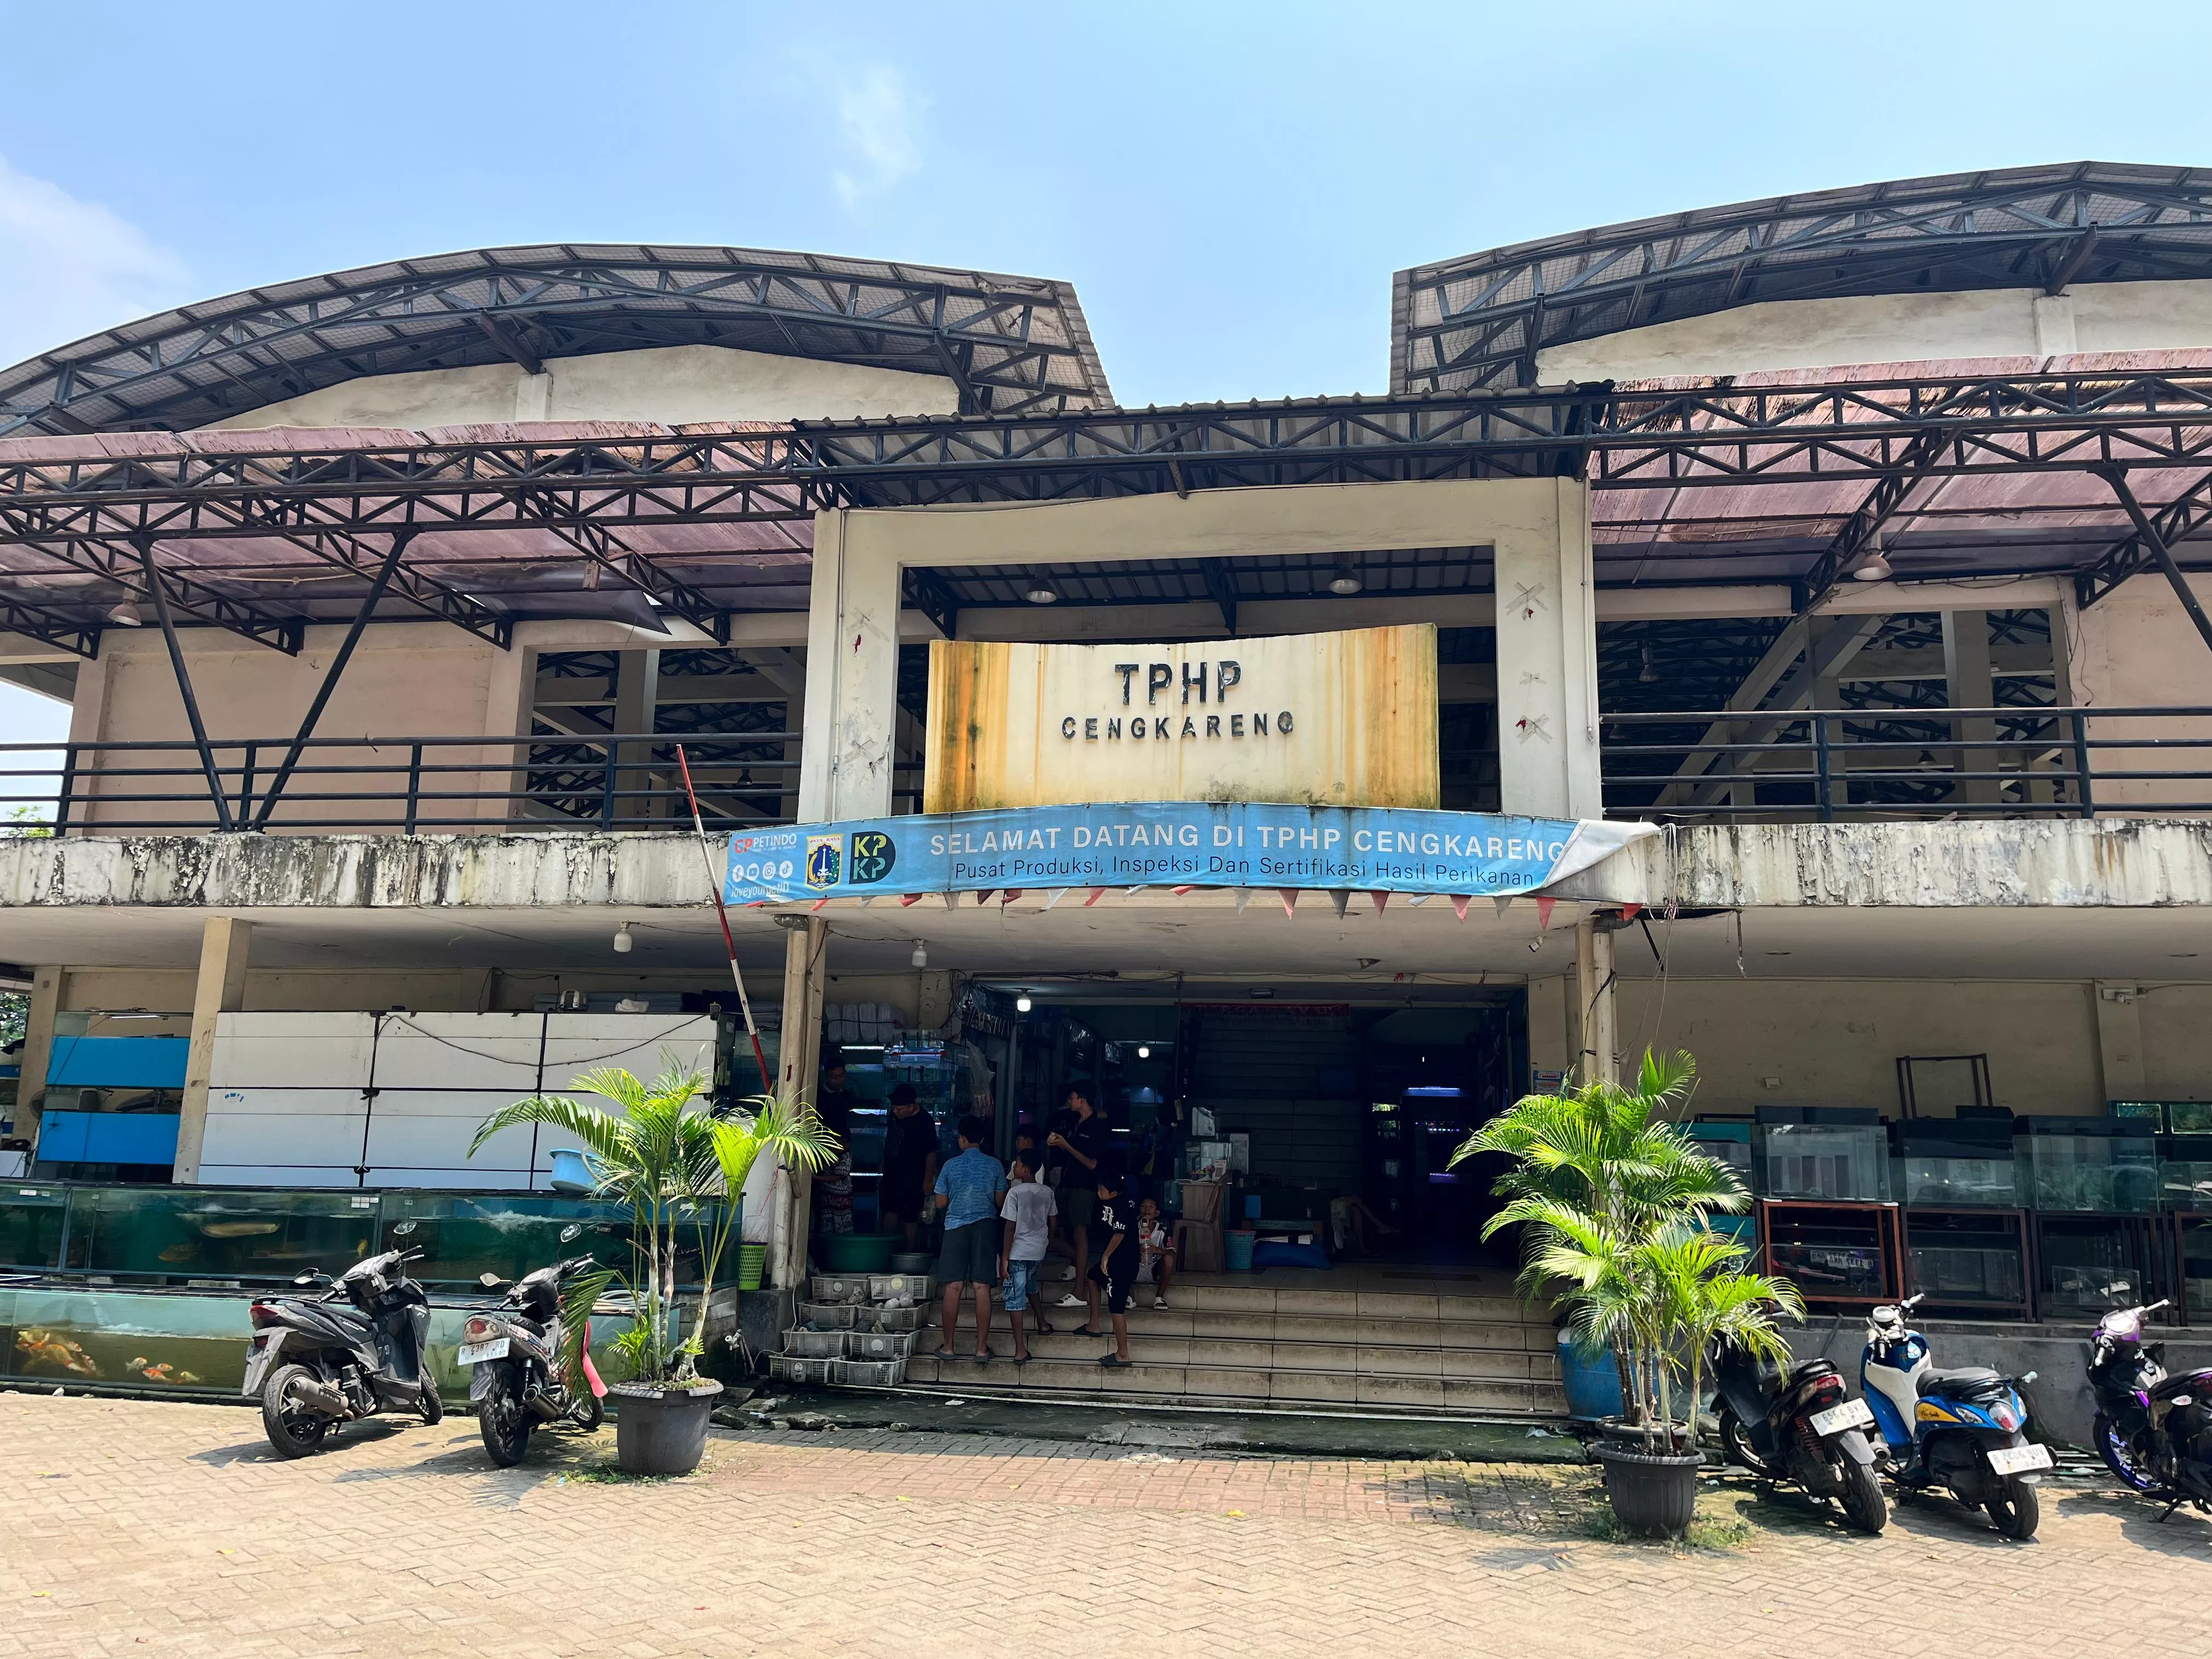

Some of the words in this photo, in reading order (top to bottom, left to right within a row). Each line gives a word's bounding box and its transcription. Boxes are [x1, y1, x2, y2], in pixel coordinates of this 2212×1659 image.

[1115, 660, 1242, 706] TPHP
[1062, 710, 1294, 740] CENGKARENG
[930, 827, 1061, 856] SELAMAT
[1074, 824, 1199, 849] DATANG
[1213, 825, 1244, 848] DI
[1257, 826, 1341, 851] TPHP
[1354, 830, 1565, 863] CENGKARENG
[955, 861, 1005, 878] Pusat
[1014, 856, 1104, 878] Produksi,
[1113, 856, 1200, 877] Inspeksi
[1210, 856, 1250, 874] Dan
[1260, 857, 1366, 877] Sertifikasi
[1376, 862, 1426, 881] Hasil
[1436, 865, 1534, 886] Perikanan
